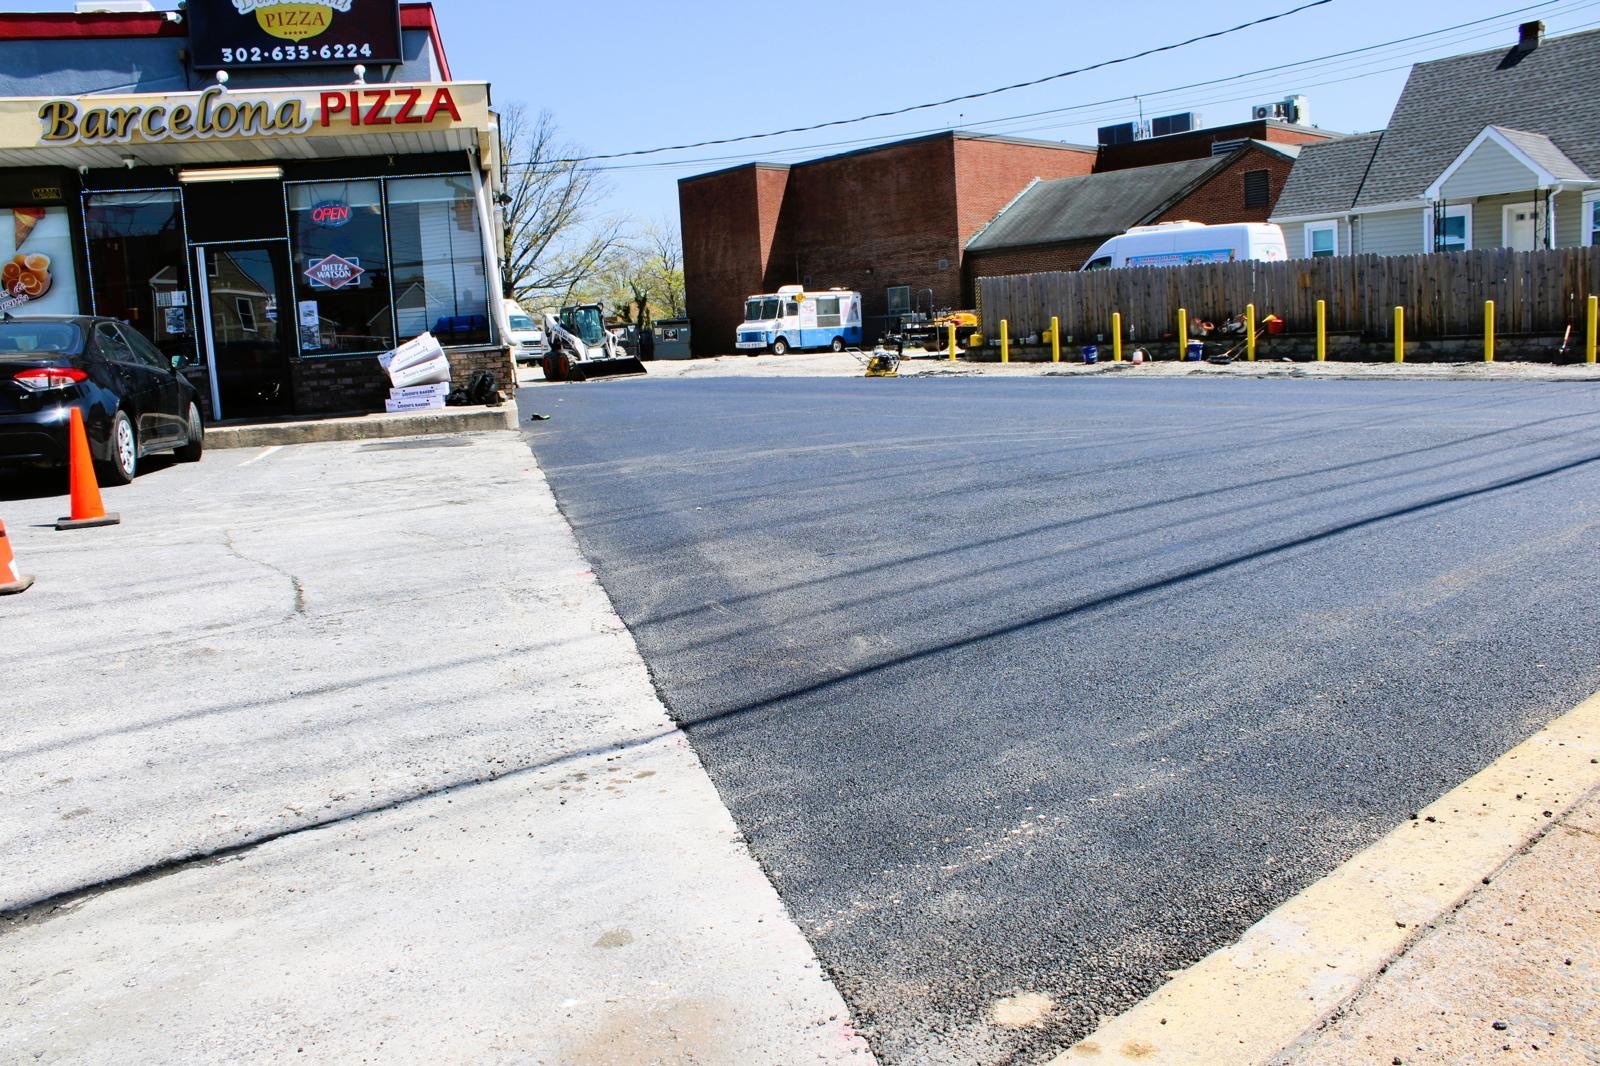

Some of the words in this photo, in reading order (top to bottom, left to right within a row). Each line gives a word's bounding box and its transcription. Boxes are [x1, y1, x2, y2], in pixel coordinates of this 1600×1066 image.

[264, 11, 326, 28] PIZZA
[38, 88, 307, 141] Barcelona
[320, 87, 462, 127] PIZZA
[313, 207, 349, 221] OPEN
[317, 270, 352, 279] WATSON
[321, 263, 344, 272] DIETZ
